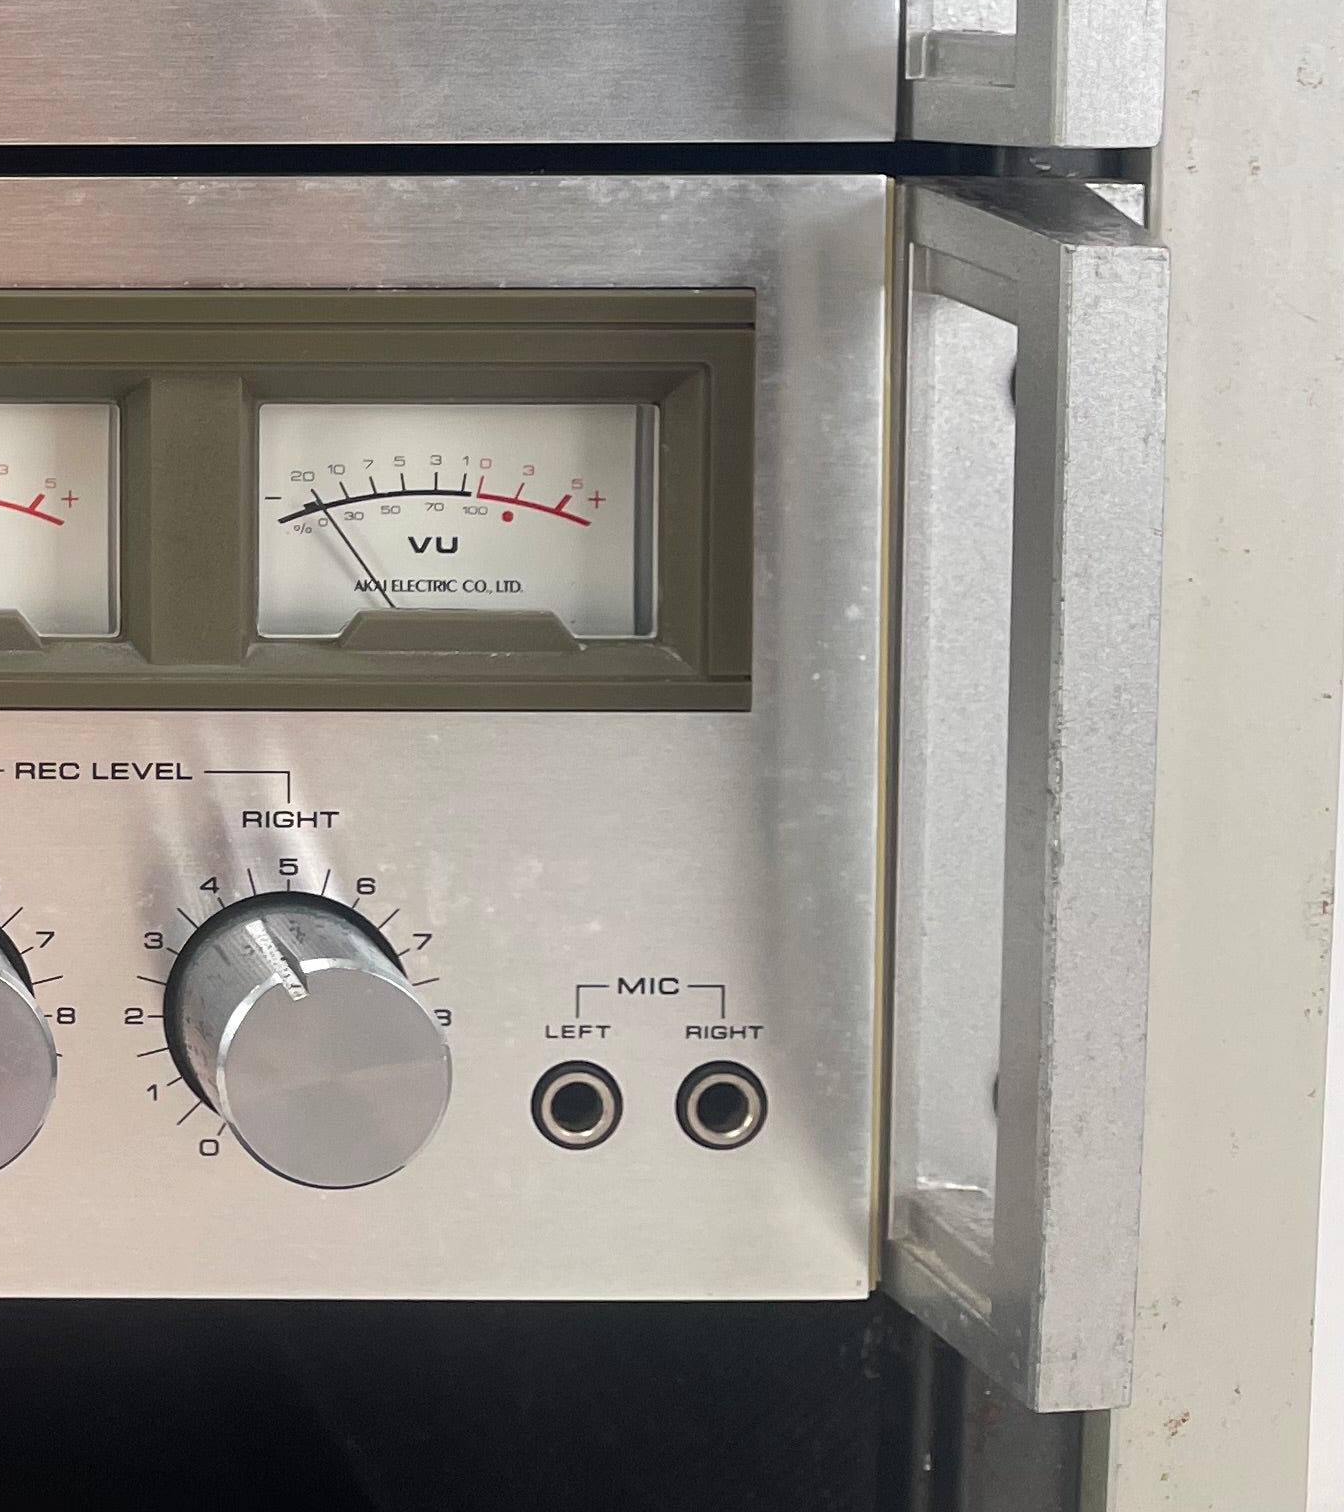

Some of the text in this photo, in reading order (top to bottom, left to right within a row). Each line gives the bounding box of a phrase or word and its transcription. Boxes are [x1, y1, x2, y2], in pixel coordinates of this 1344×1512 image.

[407, 536, 459, 554] VU
[353, 579, 522, 595] AKAI ELECTRIC CO., LTD.
[15, 761, 193, 781] REC LEVEL
[242, 810, 340, 829] RIGHT
[35, 931, 55, 949] 7
[617, 977, 680, 996] MIC
[56, 1006, 76, 1025] 8
[545, 1024, 612, 1039] LEFT
[685, 1025, 765, 1040] RIGHT
